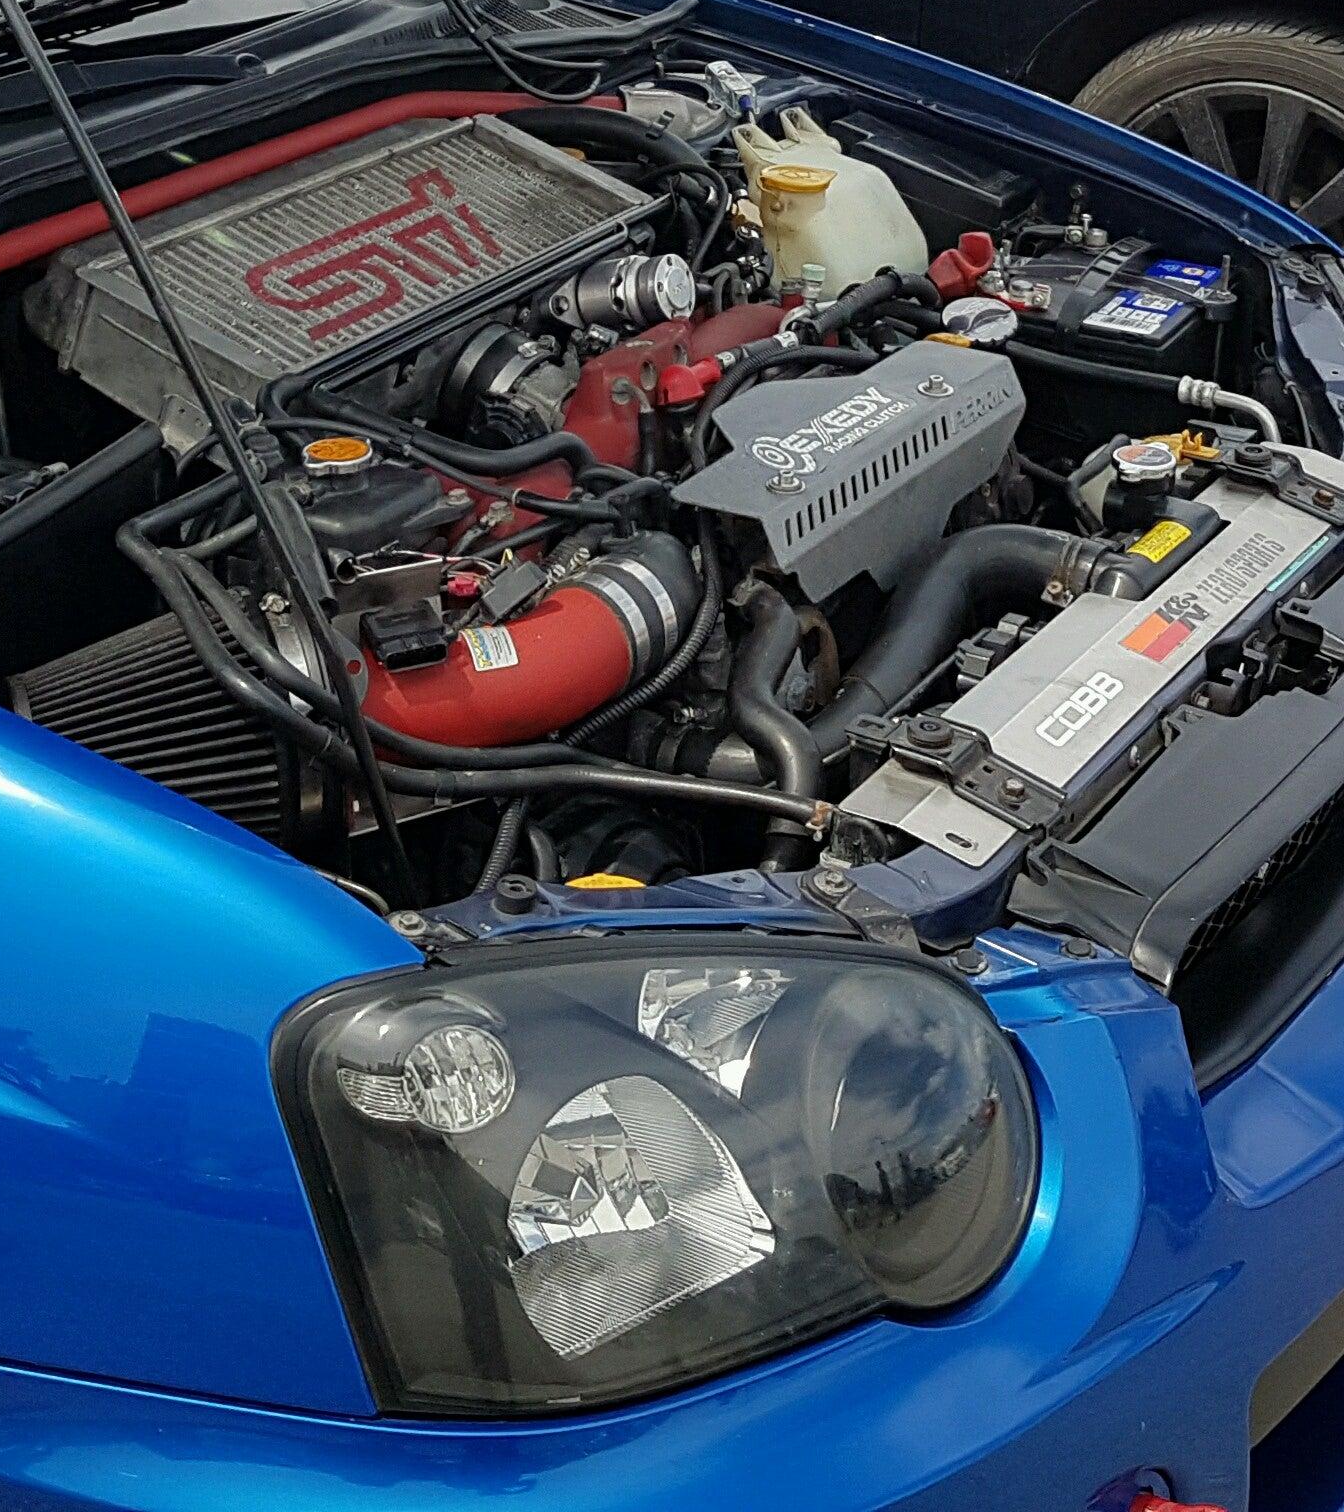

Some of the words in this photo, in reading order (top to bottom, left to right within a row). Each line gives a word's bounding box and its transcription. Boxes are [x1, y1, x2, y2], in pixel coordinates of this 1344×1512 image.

[779, 386, 892, 453] EXEDY
[862, 401, 909, 432] CLUTCH
[1034, 670, 1124, 748] COBB
